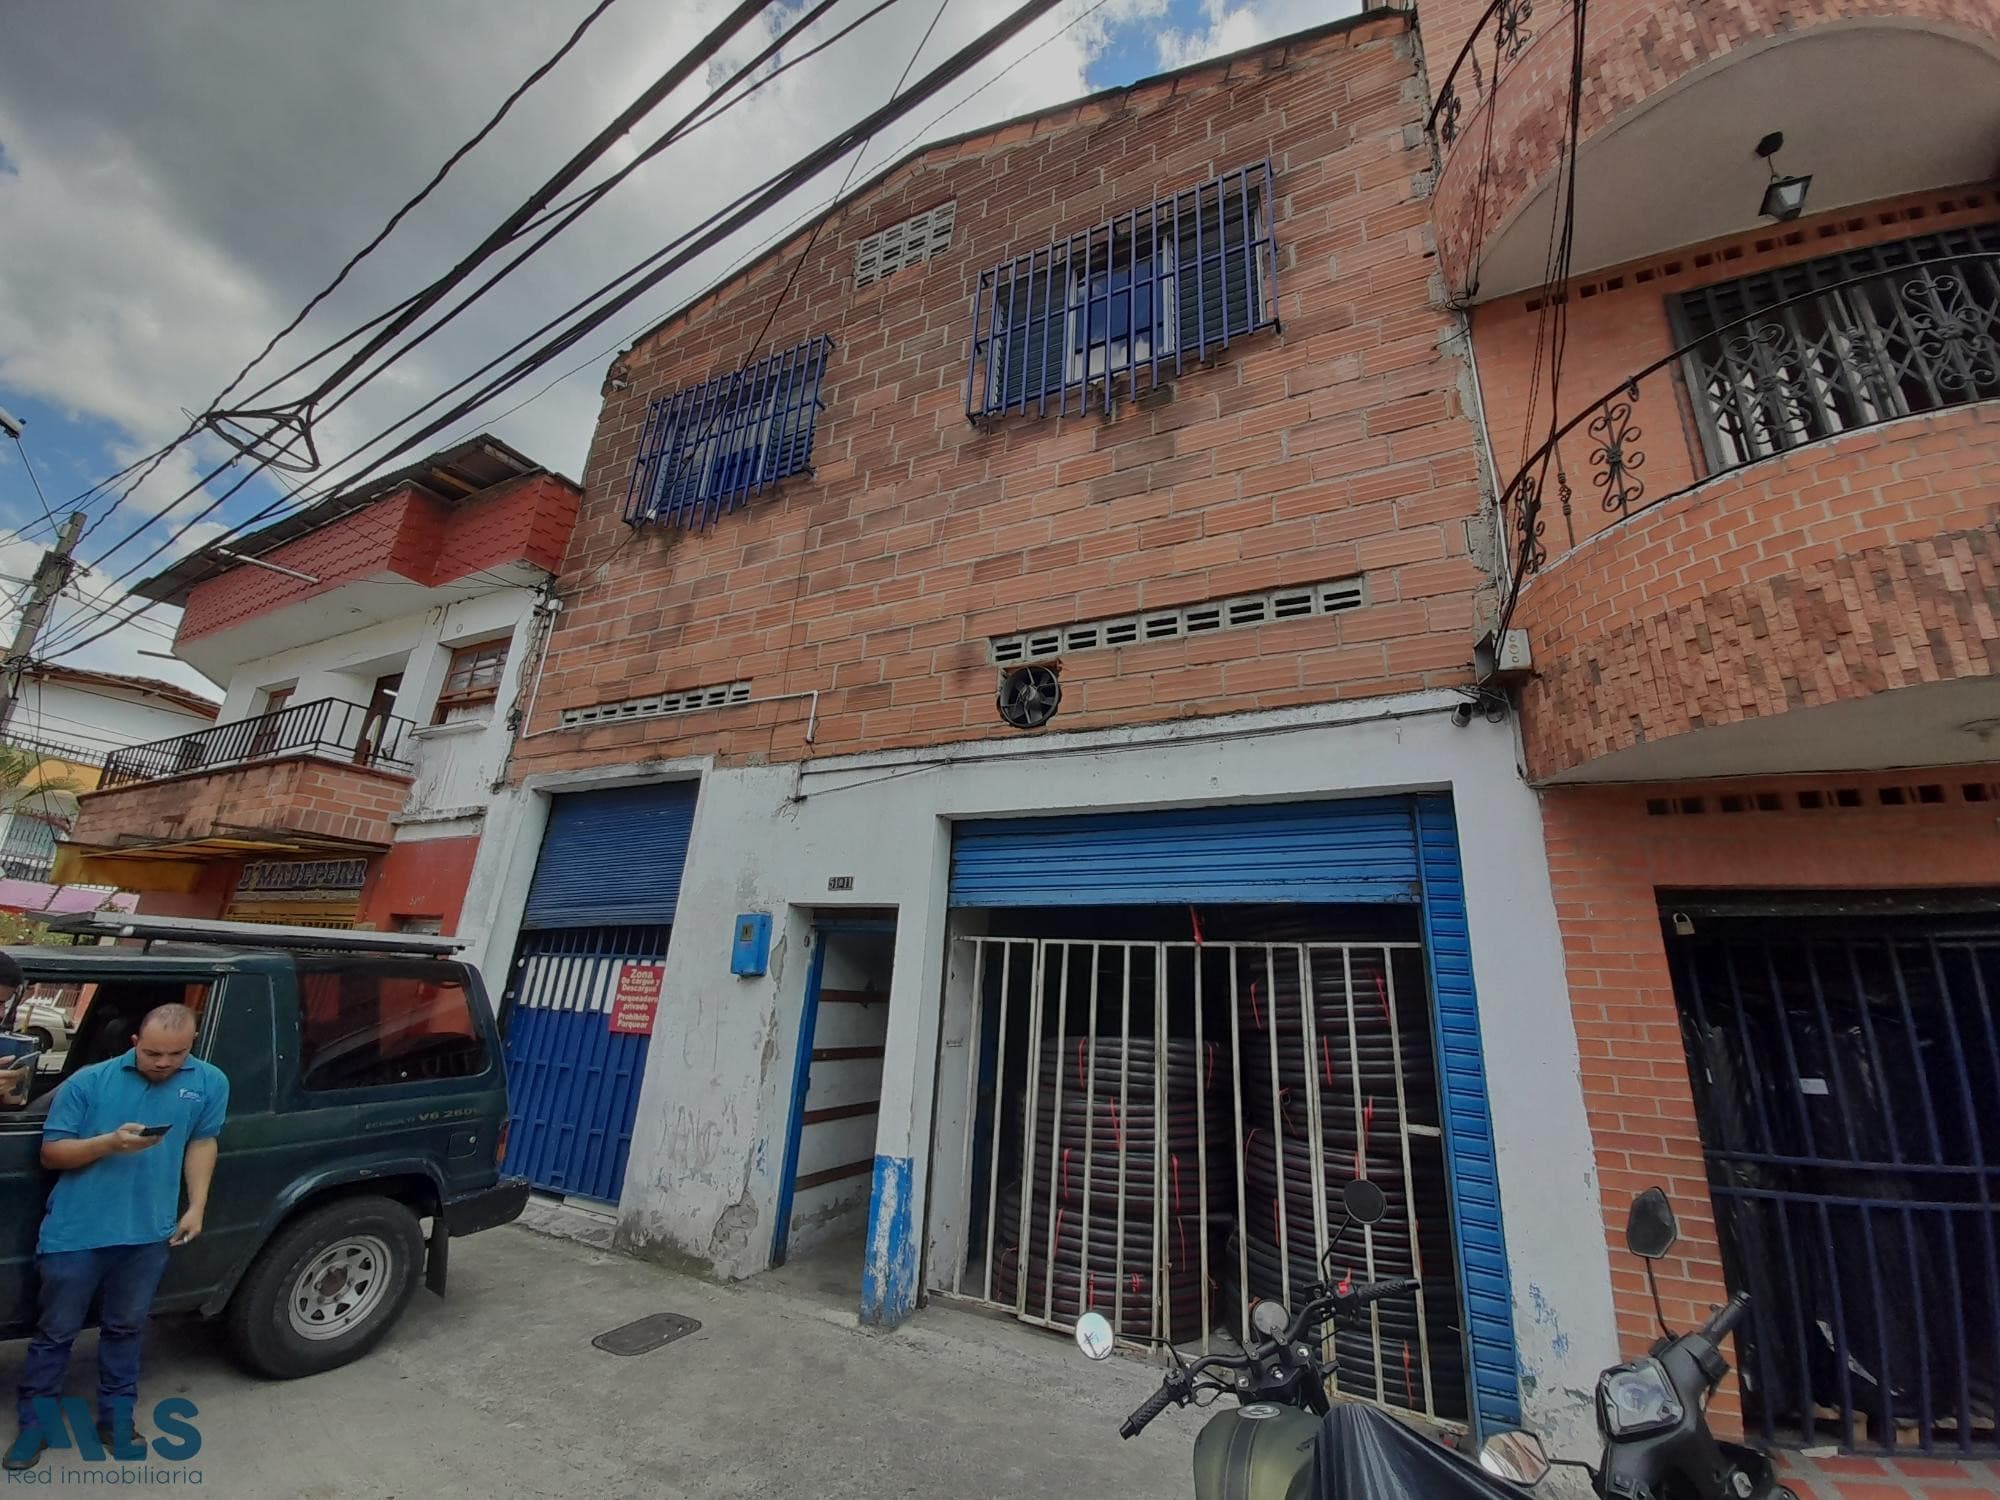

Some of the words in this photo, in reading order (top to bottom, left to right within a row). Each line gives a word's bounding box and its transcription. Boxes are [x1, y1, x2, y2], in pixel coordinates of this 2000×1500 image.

[630, 969, 653, 979] Zona
[632, 978, 655, 986] cargue
[622, 984, 657, 993] Descargue
[616, 994, 659, 1003] Parqueadero
[623, 1003, 648, 1011] privado
[618, 1012, 650, 1021] Prohibido
[617, 1020, 648, 1030] Parquear
